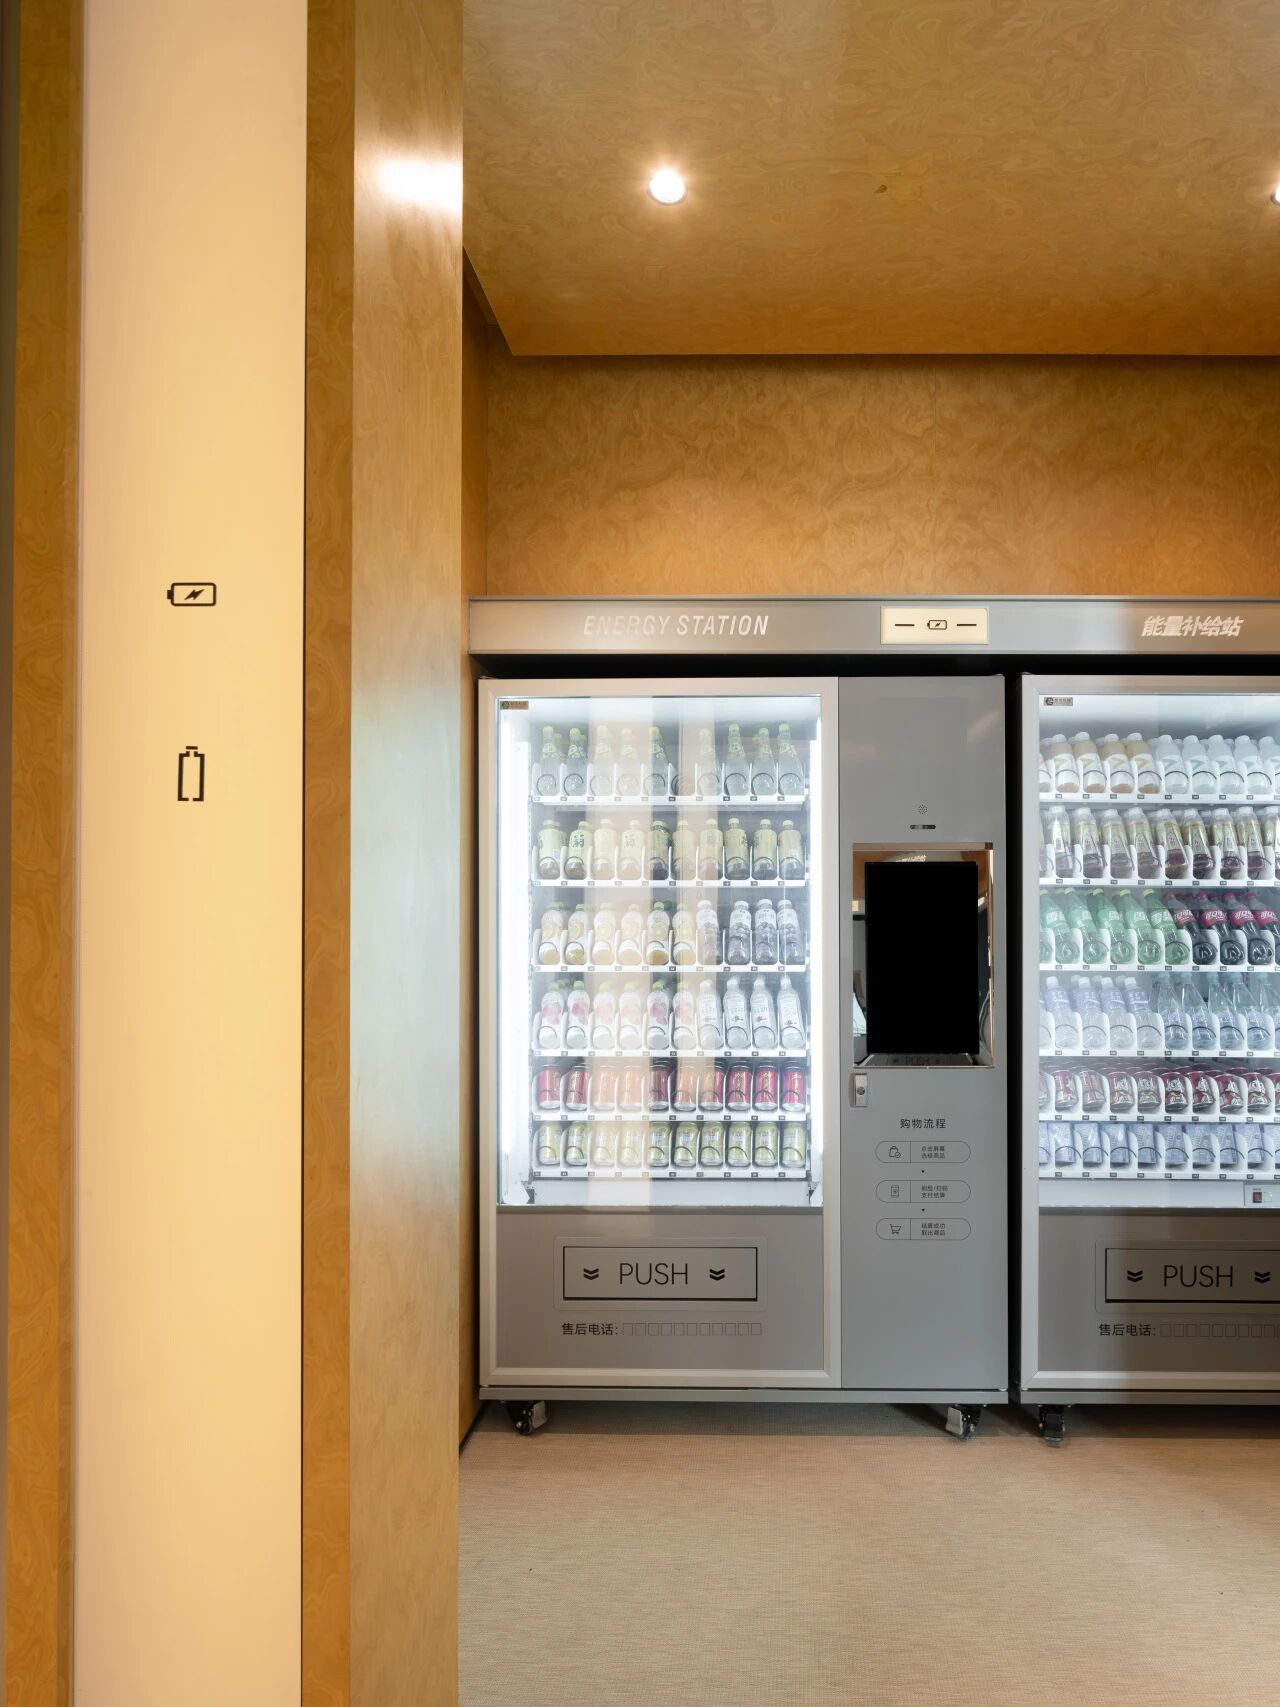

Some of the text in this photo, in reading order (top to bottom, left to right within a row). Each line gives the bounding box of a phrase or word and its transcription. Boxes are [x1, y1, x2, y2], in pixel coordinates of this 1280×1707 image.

[583, 615, 769, 636] ENERGY STATION
[1141, 615, 1244, 637] 能量补给站
[900, 1118, 947, 1129] 购物流程
[619, 1262, 688, 1285] PUSH
[1163, 1264, 1233, 1288] PUSH
[561, 1322, 619, 1336] 售后电话:
[1098, 1323, 1156, 1337] 售后电话:
